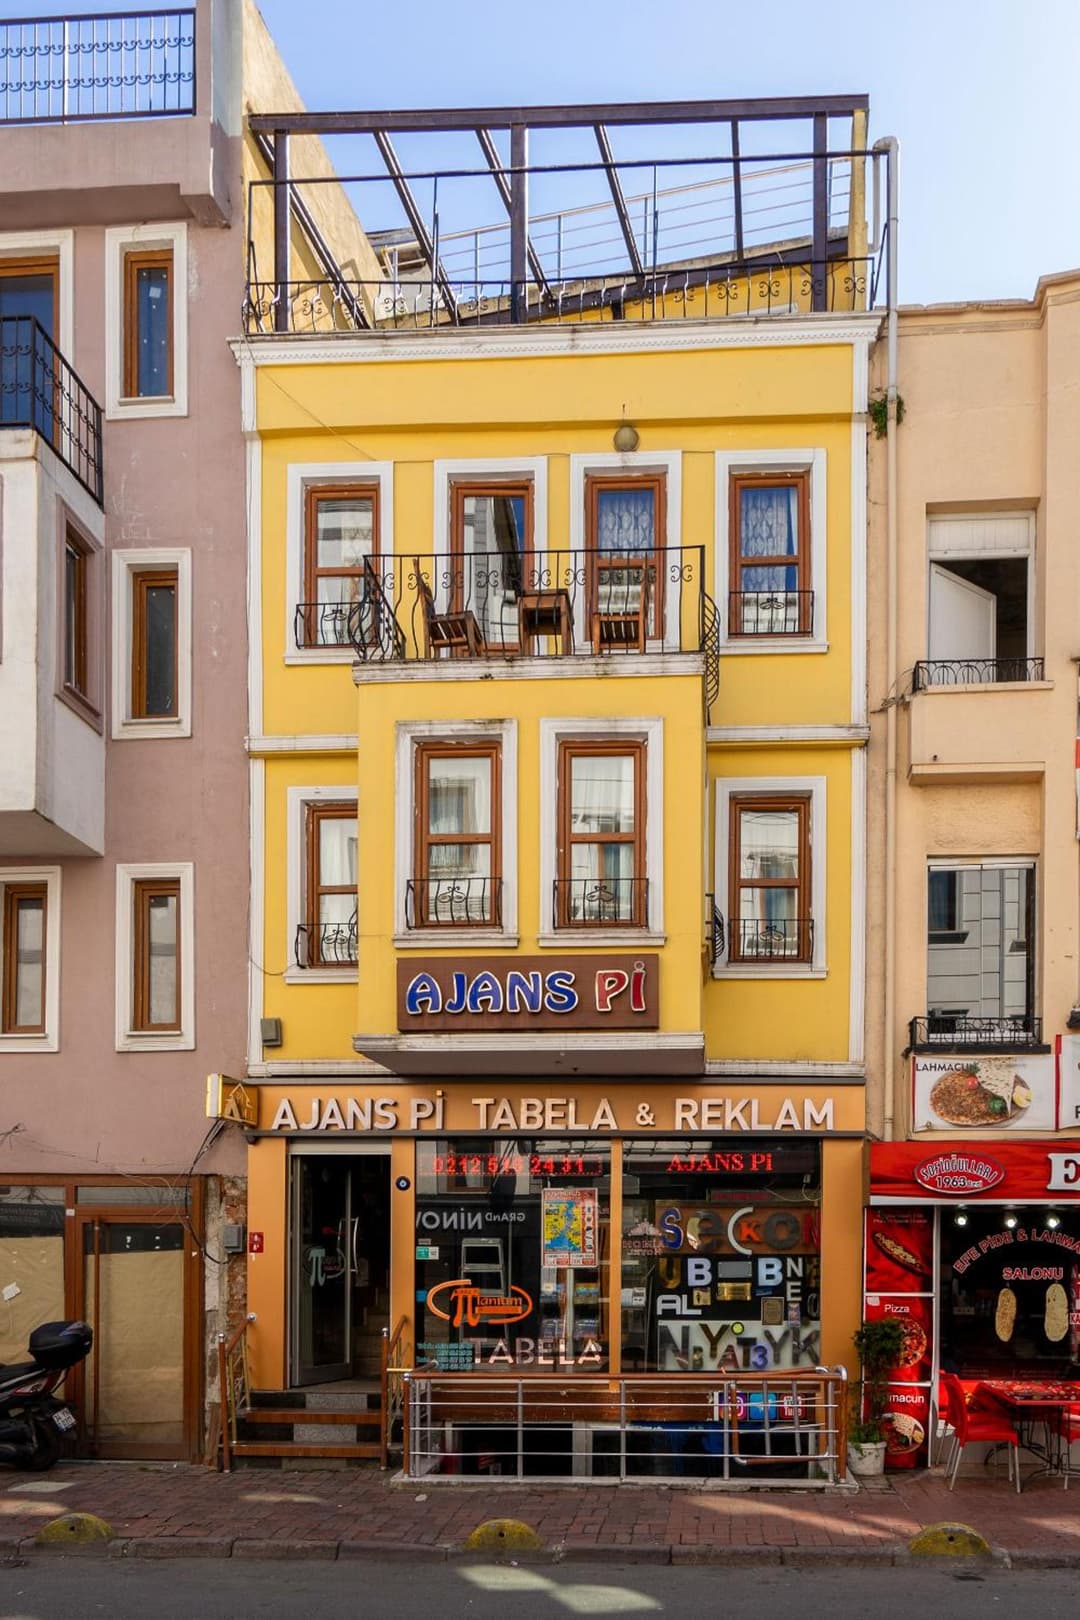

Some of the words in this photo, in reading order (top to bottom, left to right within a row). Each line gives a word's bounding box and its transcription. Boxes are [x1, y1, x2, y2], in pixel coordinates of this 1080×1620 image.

[405, 970, 579, 1014] AJANS
[271, 1097, 398, 1131] AJANS
[471, 1097, 619, 1131] TABELA
[635, 1102, 656, 1126] &
[675, 1097, 835, 1131] REKLAM
[666, 1153, 744, 1172] AJANS
[936, 1175, 967, 1188] 1963
[953, 1246, 981, 1274] EFE
[1016, 1228, 1028, 1242] &
[1002, 1266, 1064, 1280] SALONU
[884, 1304, 910, 1313] Pizza
[469, 1337, 603, 1365] TABELA
